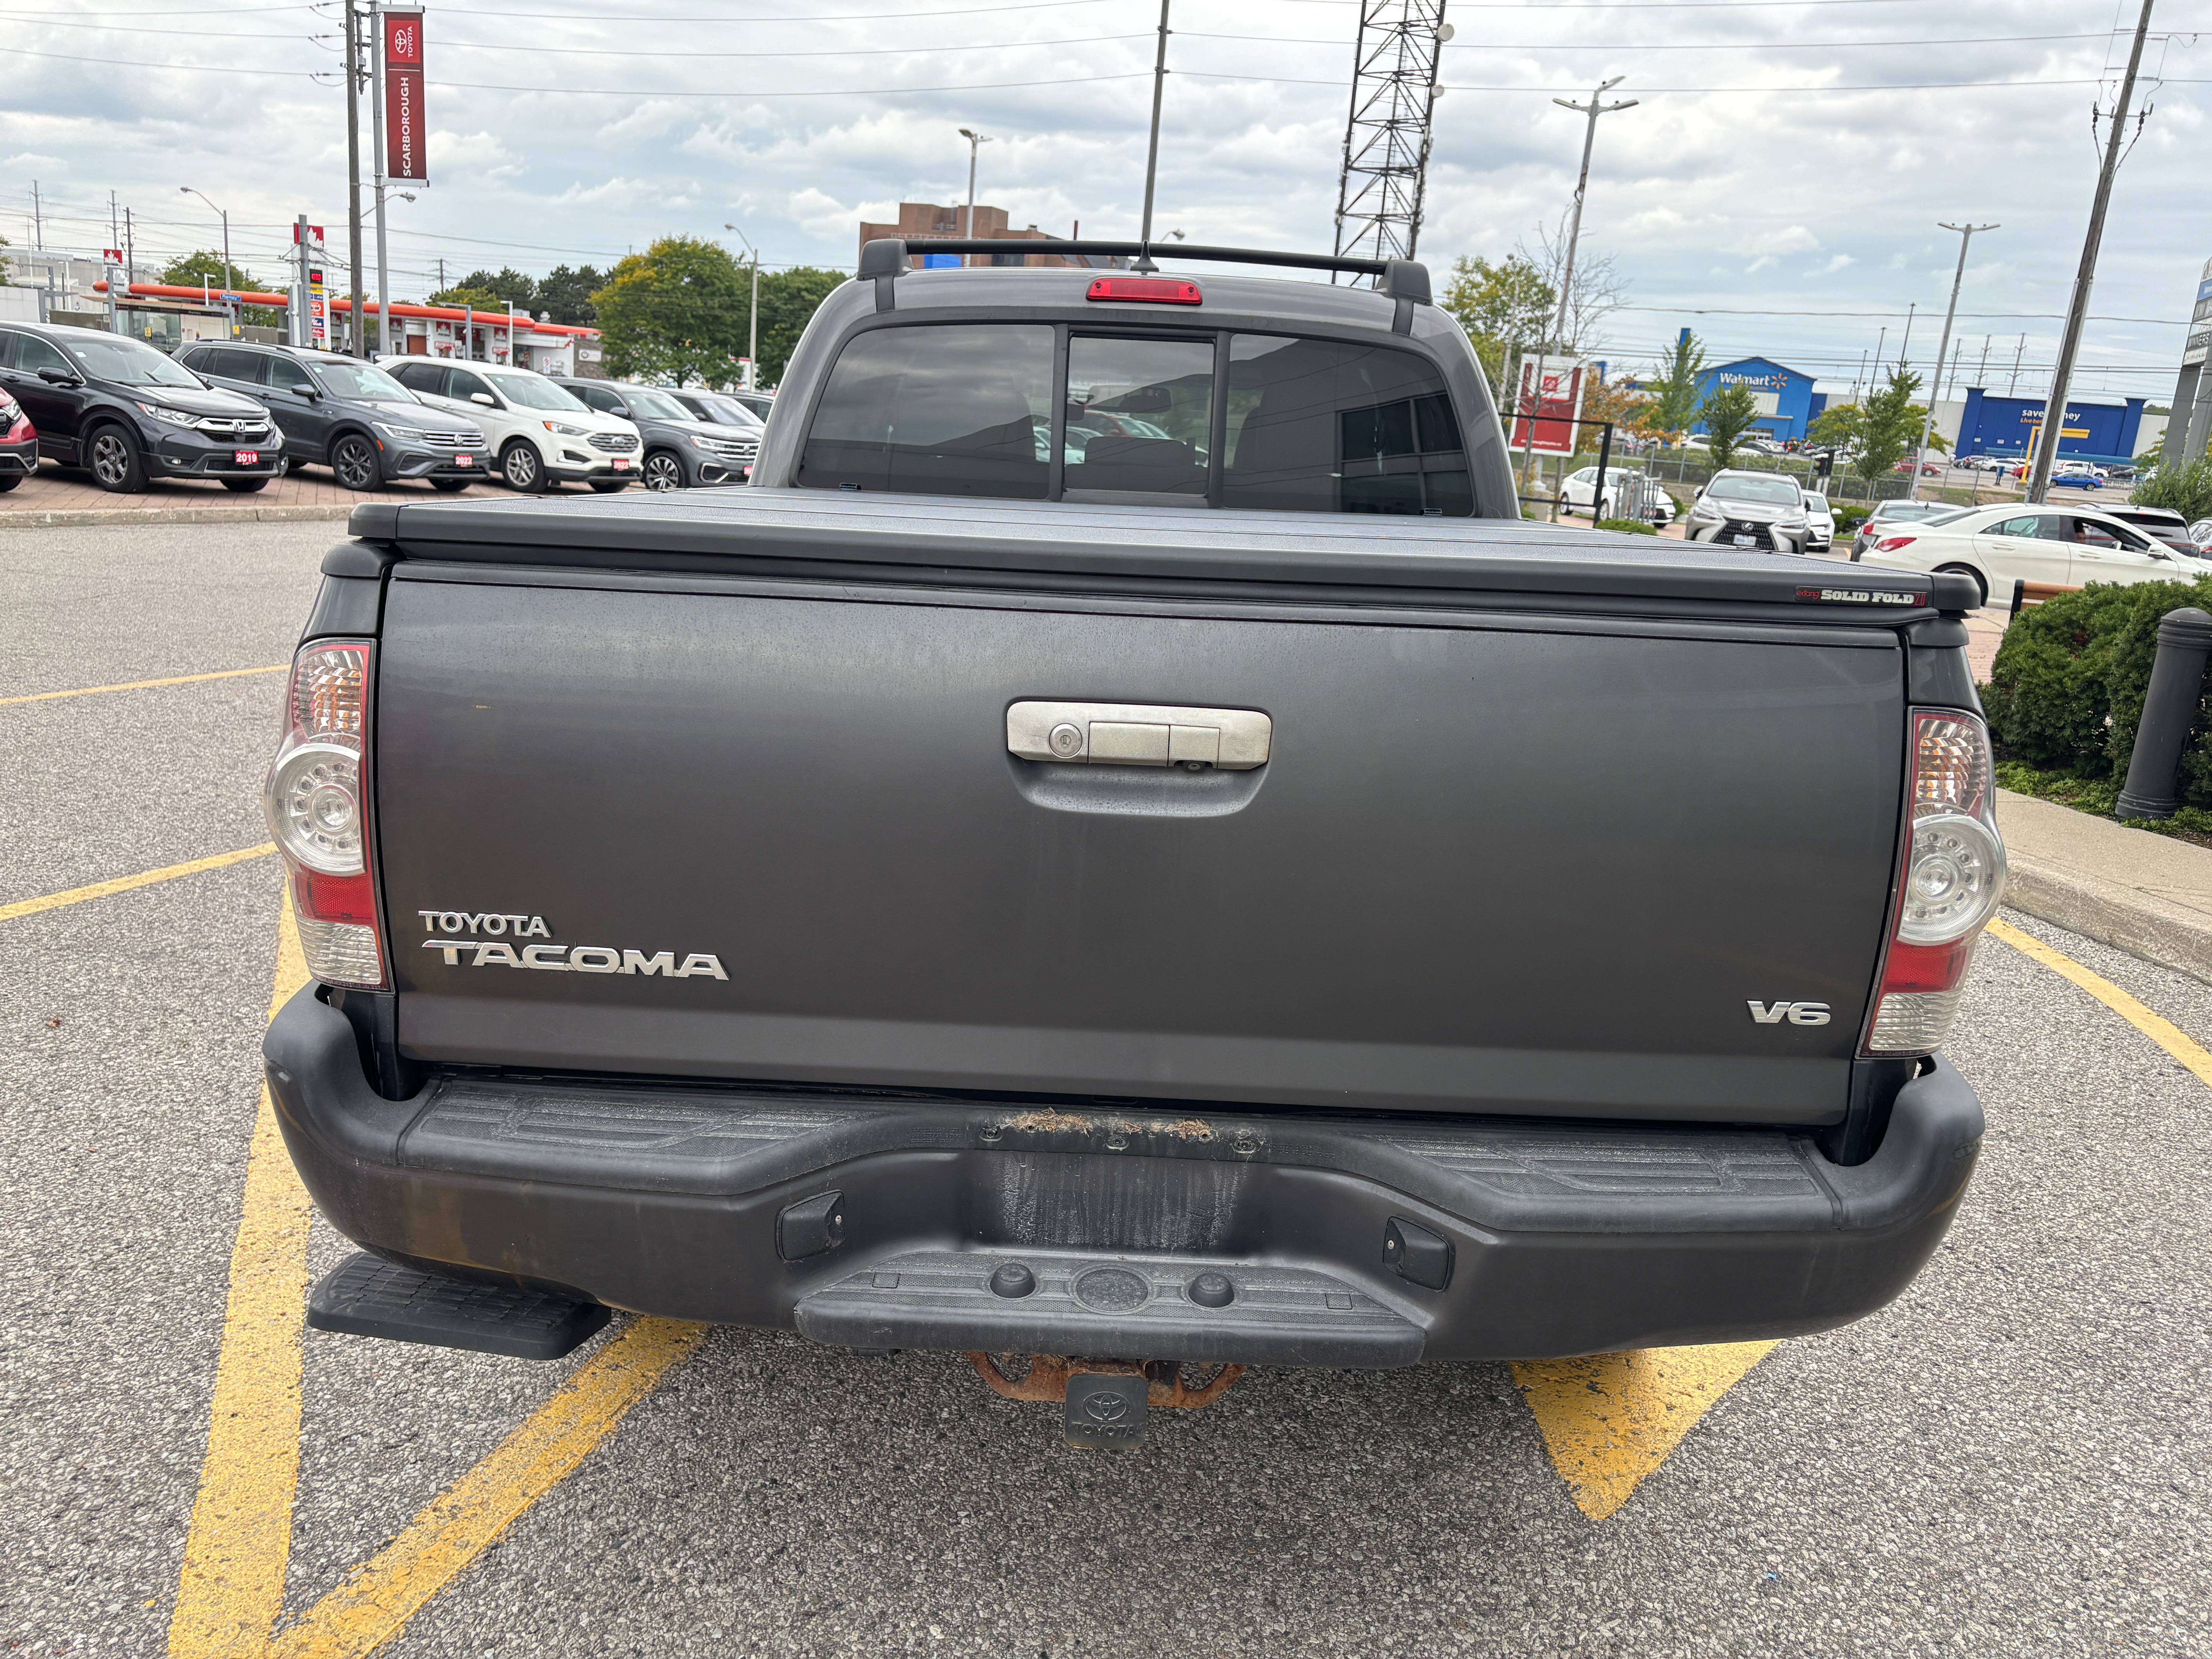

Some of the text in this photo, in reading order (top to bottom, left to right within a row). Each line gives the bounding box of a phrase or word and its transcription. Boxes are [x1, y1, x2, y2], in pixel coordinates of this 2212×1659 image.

[400, 77, 411, 177] SCARBOROUGH
[2187, 333, 2210, 348] WINNERS
[1720, 373, 1770, 386] Walmart
[2064, 412, 2081, 422] ney
[236, 452, 257, 462] 2019
[455, 456, 472, 465] 2022
[1821, 589, 1869, 601] SOLID
[1872, 592, 1914, 604] FOLD
[418, 910, 551, 938] TOYOTA
[422, 939, 730, 981] TACOMA
[1747, 1000, 1831, 1025] V6
[1072, 1422, 1135, 1438] TOYOTA
